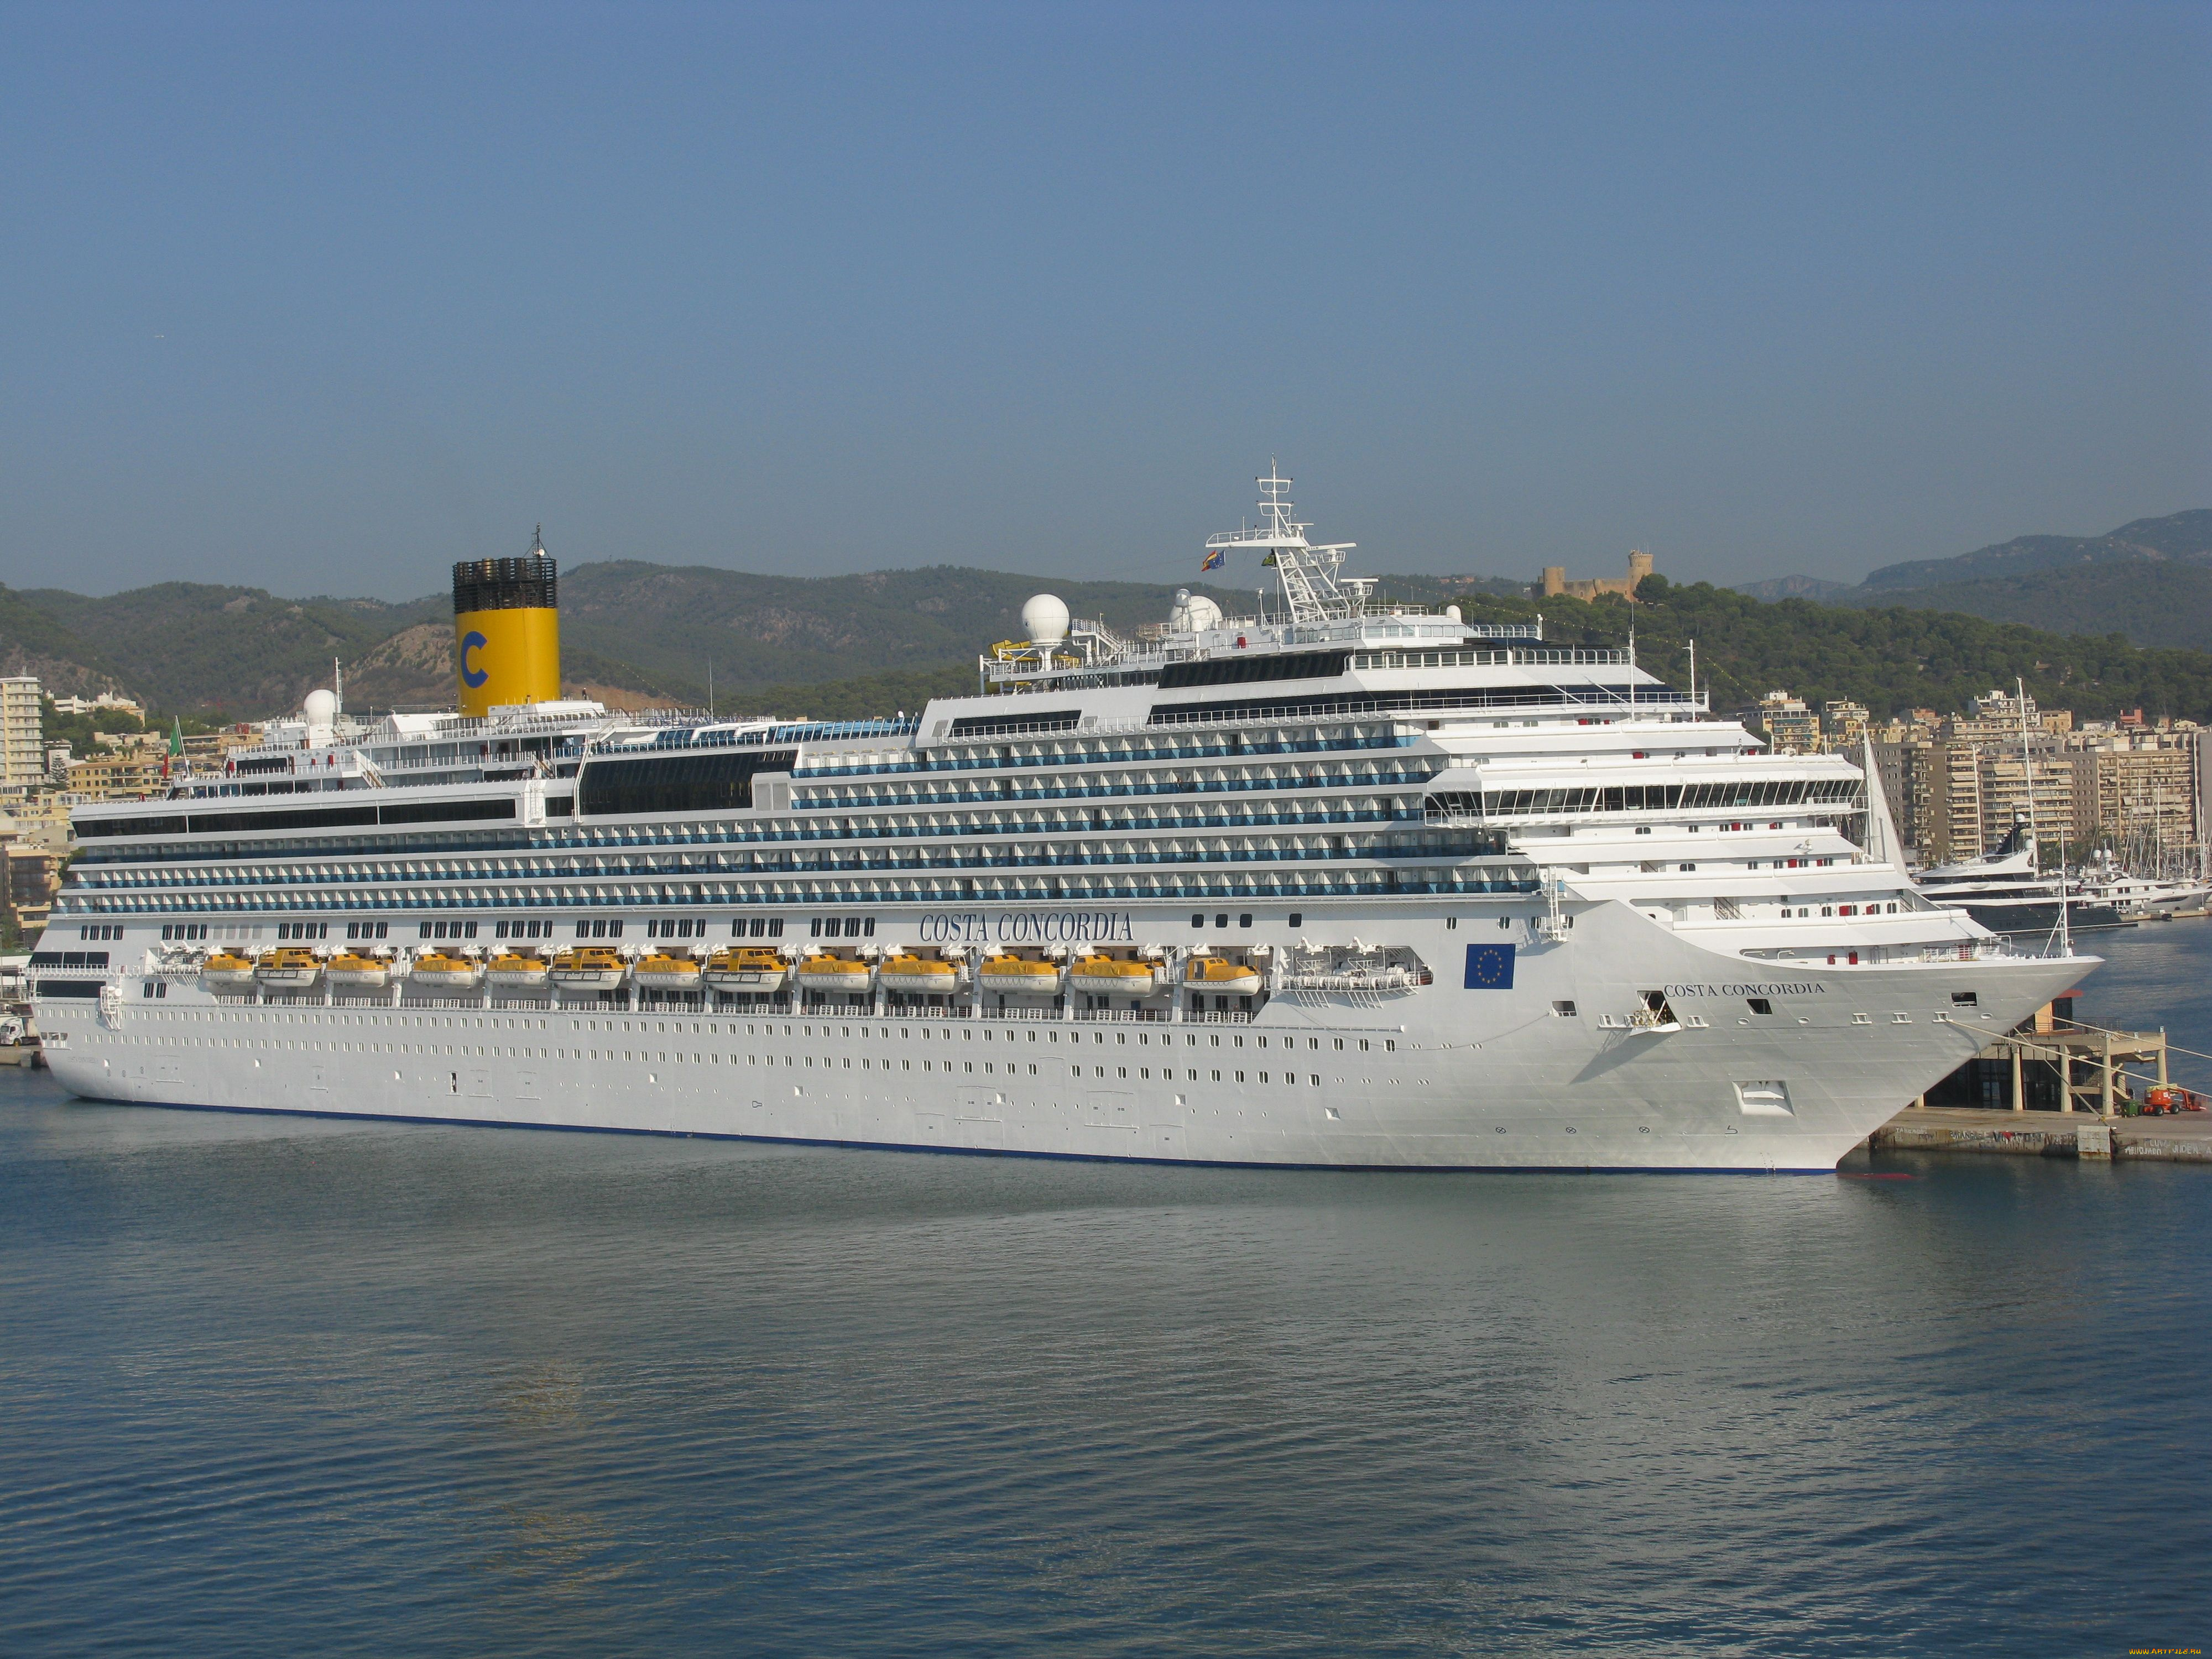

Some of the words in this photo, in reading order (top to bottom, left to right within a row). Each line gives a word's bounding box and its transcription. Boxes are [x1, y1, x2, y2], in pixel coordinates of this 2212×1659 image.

[461, 630, 489, 688] C
[920, 914, 990, 942] COSTA
[998, 912, 1134, 942] CONCORDIA
[1664, 984, 1718, 998] COSTA
[1722, 983, 1827, 997] CONCORDIA
